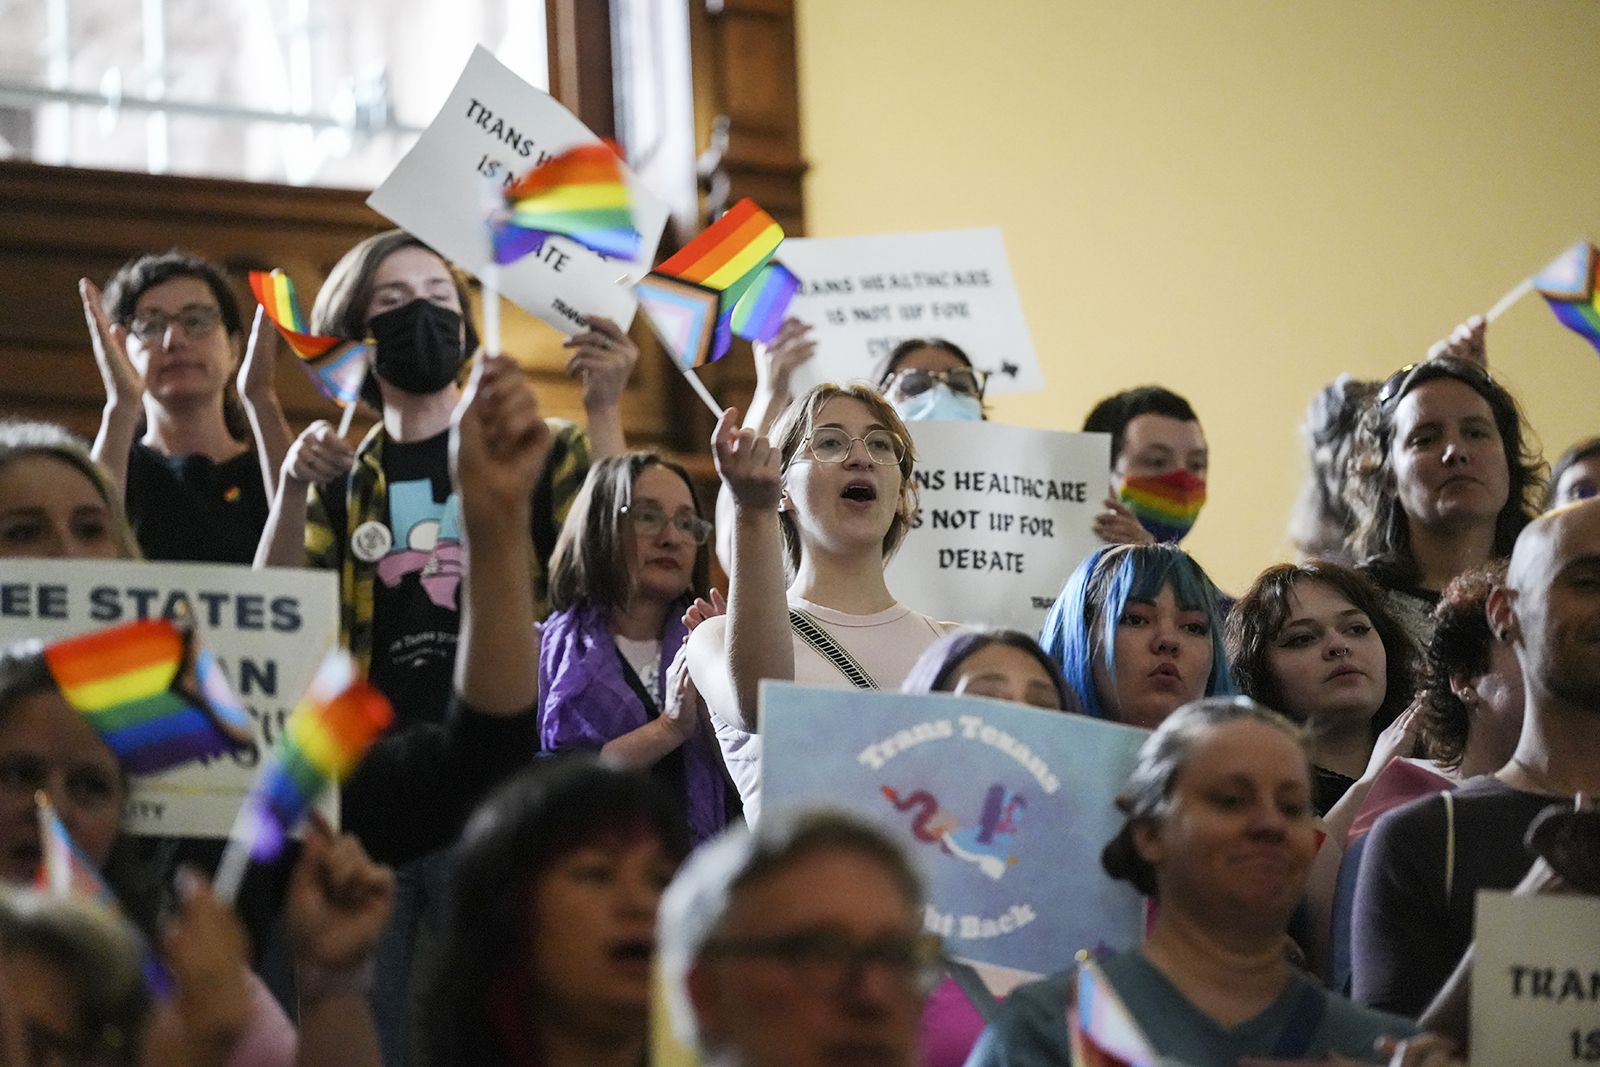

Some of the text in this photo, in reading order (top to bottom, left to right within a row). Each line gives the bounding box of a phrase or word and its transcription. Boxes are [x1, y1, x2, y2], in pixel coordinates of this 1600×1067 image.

[465, 98, 536, 157] TRANS
[476, 153, 502, 178] IS
[859, 268, 993, 291] HEALTHCARE
[852, 304, 892, 323] NOT
[953, 470, 1088, 503] HEALTHCARE
[931, 509, 981, 530] NOT
[990, 512, 1015, 532] UP
[1019, 516, 1055, 538] FOR
[938, 548, 1025, 574] DEBATE
[89, 586, 303, 633] STATES
[857, 714, 1060, 795] Trans Texans
[959, 902, 1037, 939] Back
